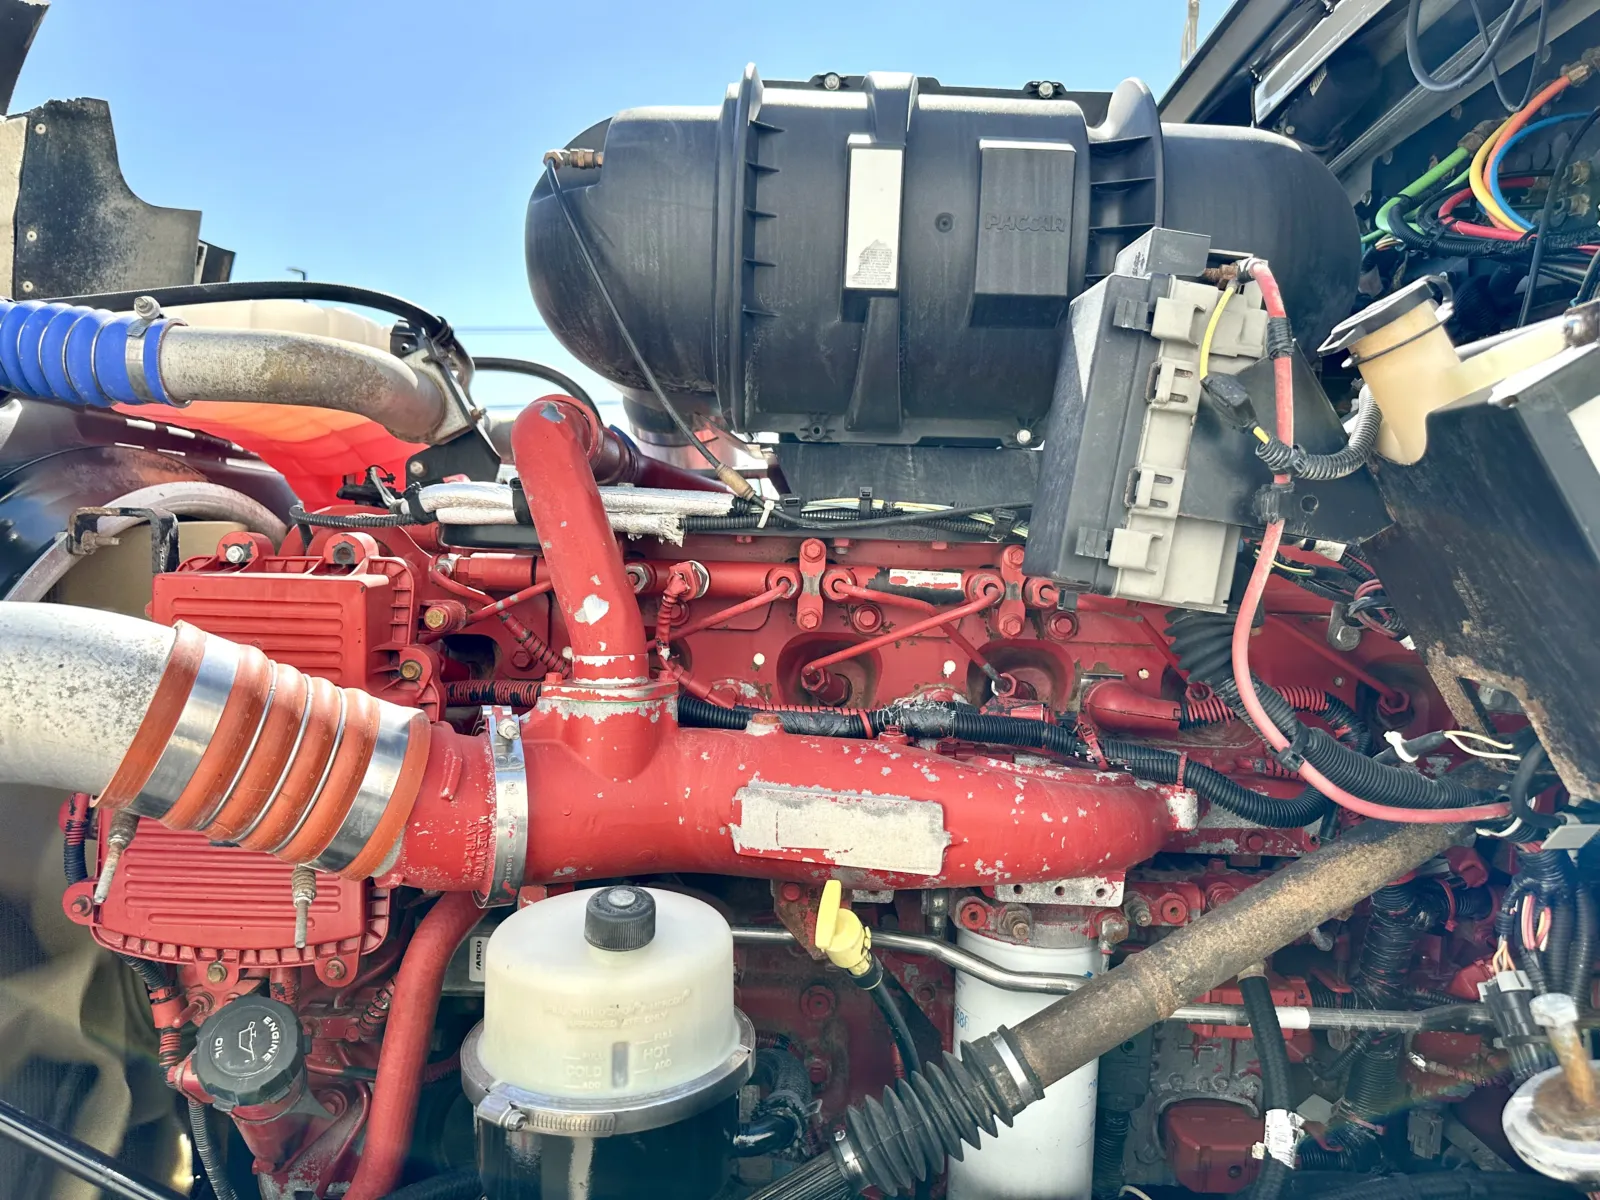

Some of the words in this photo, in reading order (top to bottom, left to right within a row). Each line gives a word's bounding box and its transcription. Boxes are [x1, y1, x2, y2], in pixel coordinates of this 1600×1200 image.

[984, 212, 1067, 232] PACCAR
[214, 1037, 224, 1059] OIL
[262, 1016, 280, 1062] ENGINE
[643, 1044, 670, 1060] HOT
[565, 1065, 602, 1078] COLD
